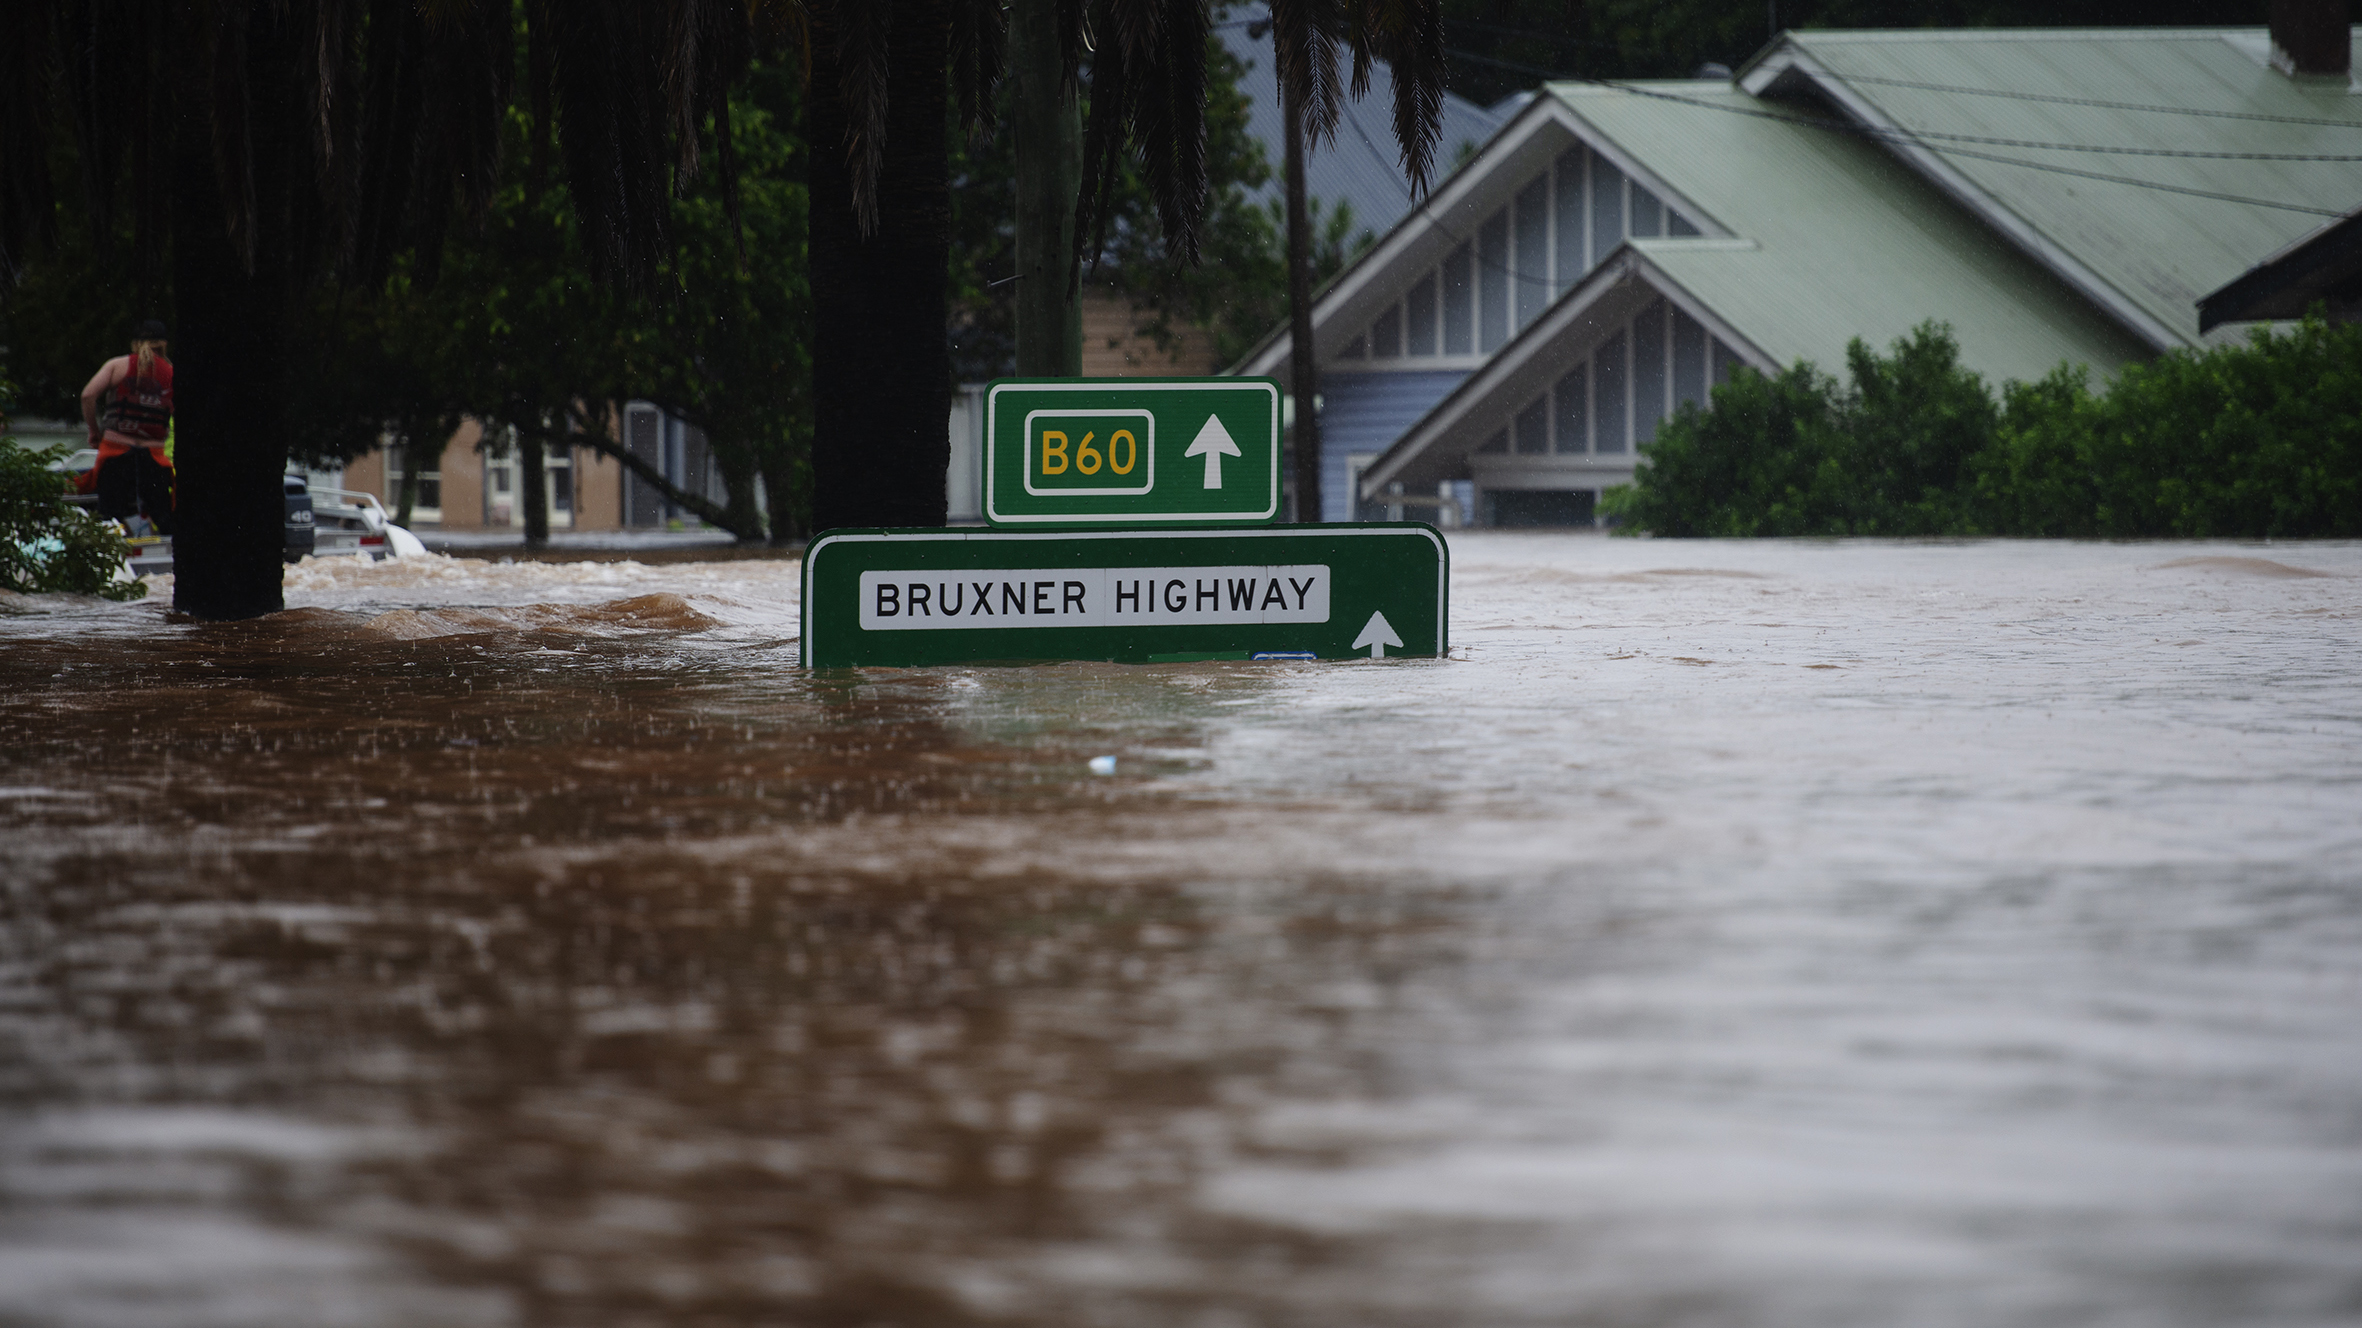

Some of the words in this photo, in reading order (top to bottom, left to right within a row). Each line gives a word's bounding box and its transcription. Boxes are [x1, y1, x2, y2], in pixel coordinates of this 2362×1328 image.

[1042, 429, 1136, 475] B60
[291, 510, 312, 523] 40
[876, 580, 1086, 617] BRUXNER
[1116, 577, 1316, 613] HIGHWAY
